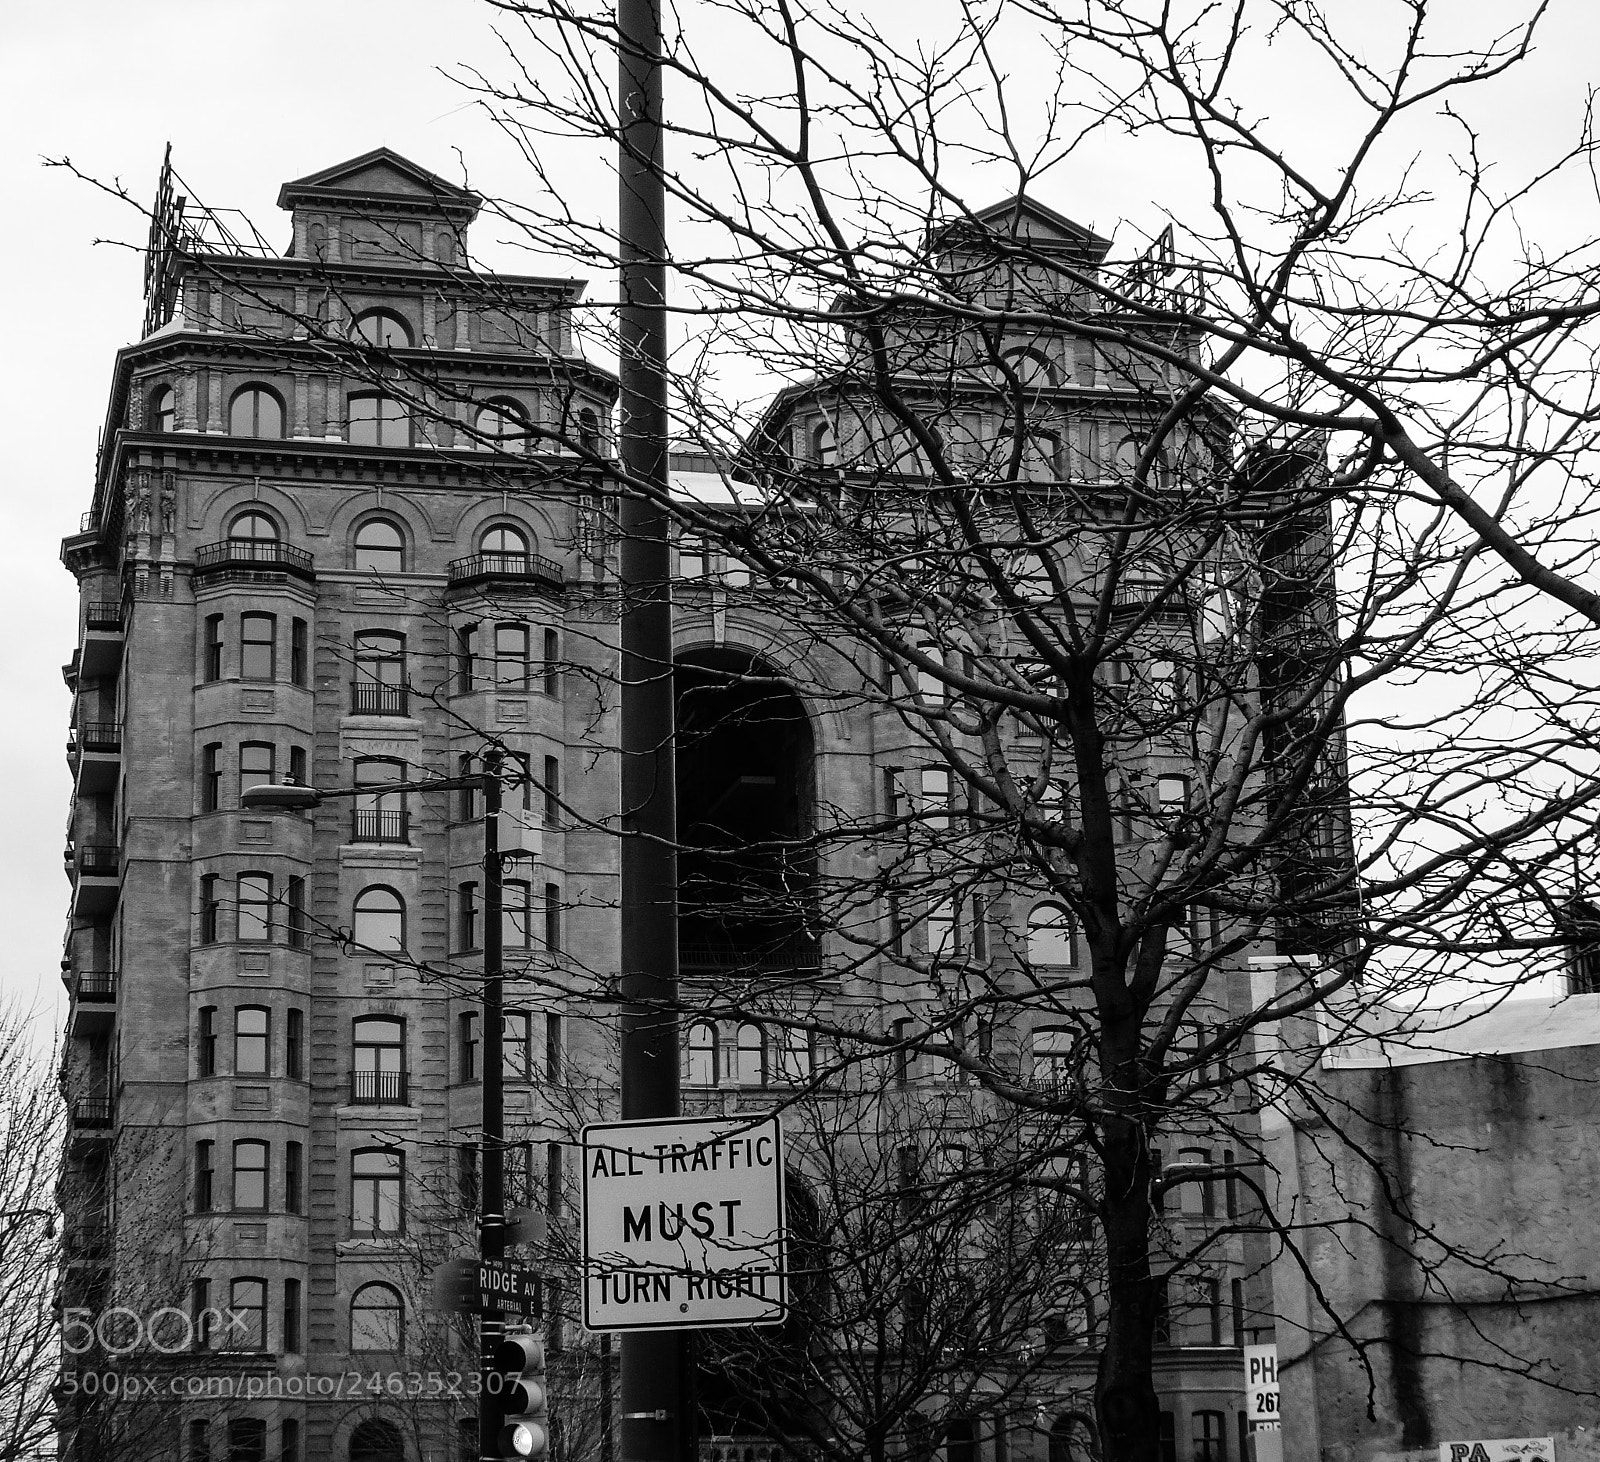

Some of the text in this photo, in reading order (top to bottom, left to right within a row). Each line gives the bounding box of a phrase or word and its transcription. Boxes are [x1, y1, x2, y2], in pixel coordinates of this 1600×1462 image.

[591, 1136, 773, 1178] ALL TRAFFIC
[623, 1199, 742, 1243] MUST
[480, 1267, 536, 1296] RIDGE AV
[597, 1266, 770, 1305] TURN RIGHT
[481, 1293, 535, 1315] W ARTERIAL E
